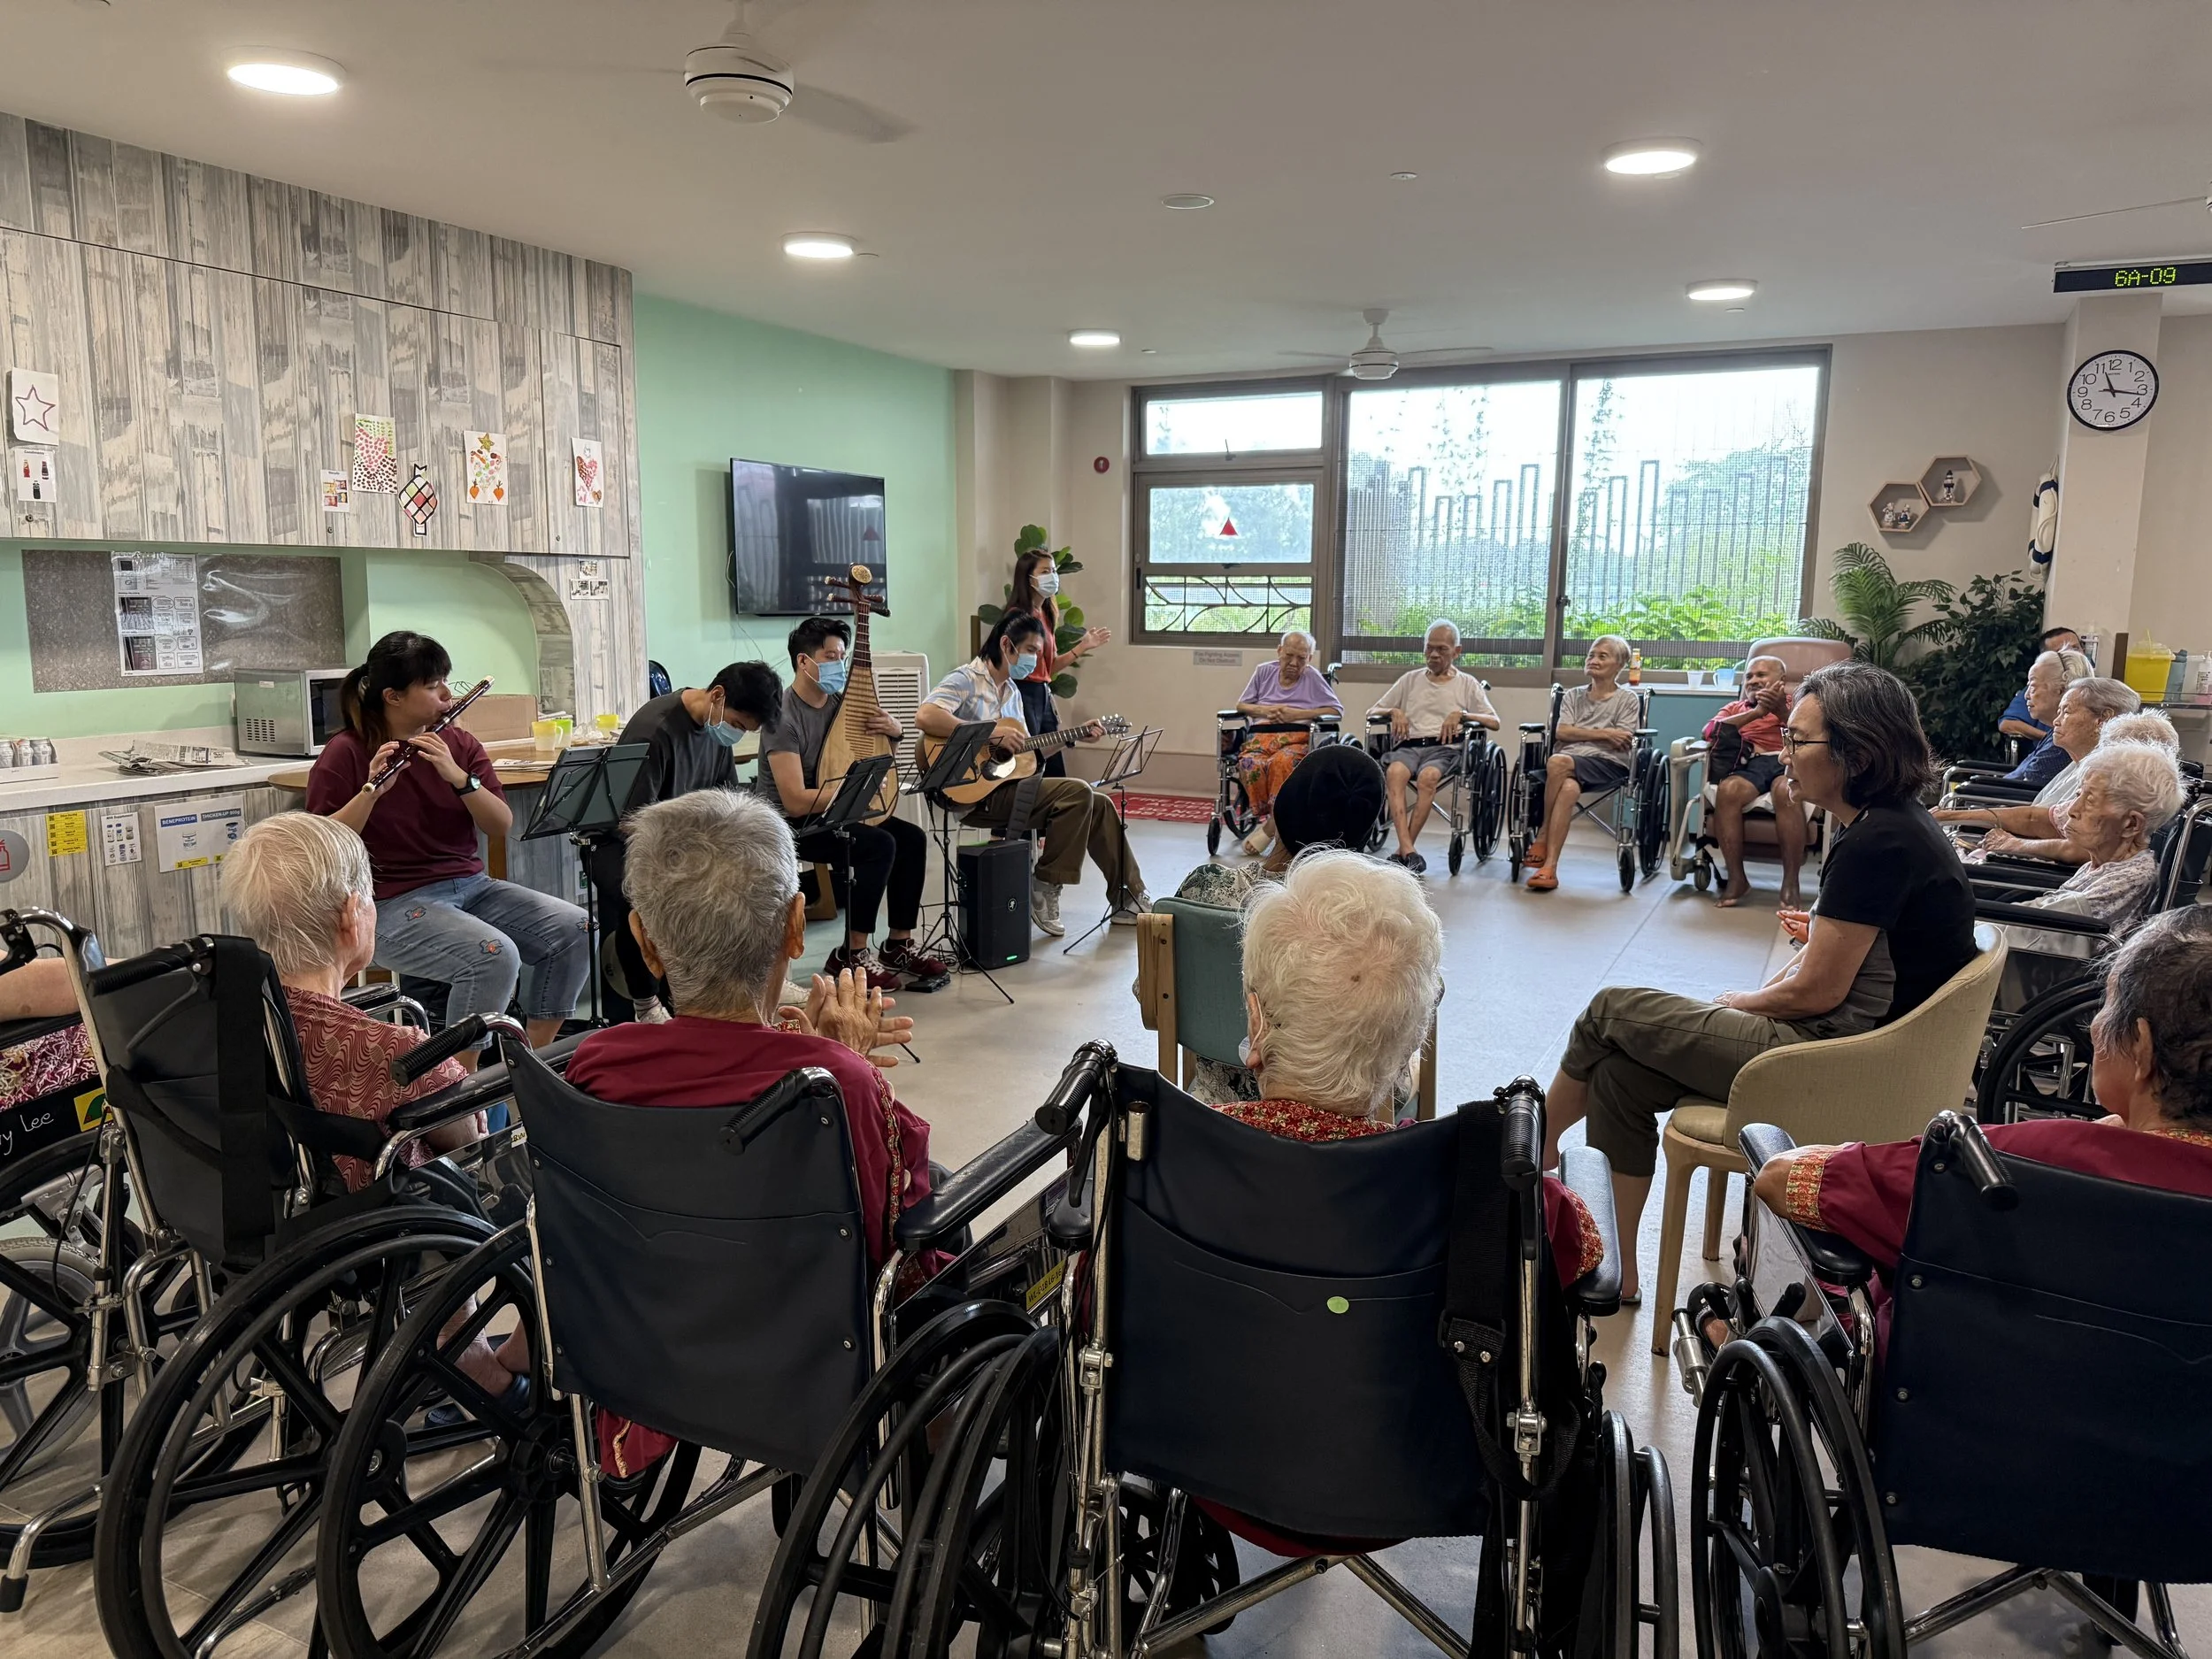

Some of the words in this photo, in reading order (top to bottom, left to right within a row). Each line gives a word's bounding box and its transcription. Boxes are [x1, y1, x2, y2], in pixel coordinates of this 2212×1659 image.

[2115, 267, 2176, 287] 6A-09
[2095, 363, 2106, 373] 11
[2108, 359, 2122, 370] 12
[2129, 362, 2132, 373] 1
[2083, 373, 2096, 385] 10
[2134, 371, 2145, 381] 2
[2078, 387, 2087, 397] 9
[2137, 384, 2147, 396] 3
[2081, 399, 2092, 410] 8
[2131, 397, 2141, 408] 4
[2093, 409, 2102, 419] 7
[2104, 411, 2115, 422] 6
[2120, 408, 2131, 419] 5
[162, 816, 196, 825] BENEPROTEIN
[20, 1112, 54, 1133] Lee
